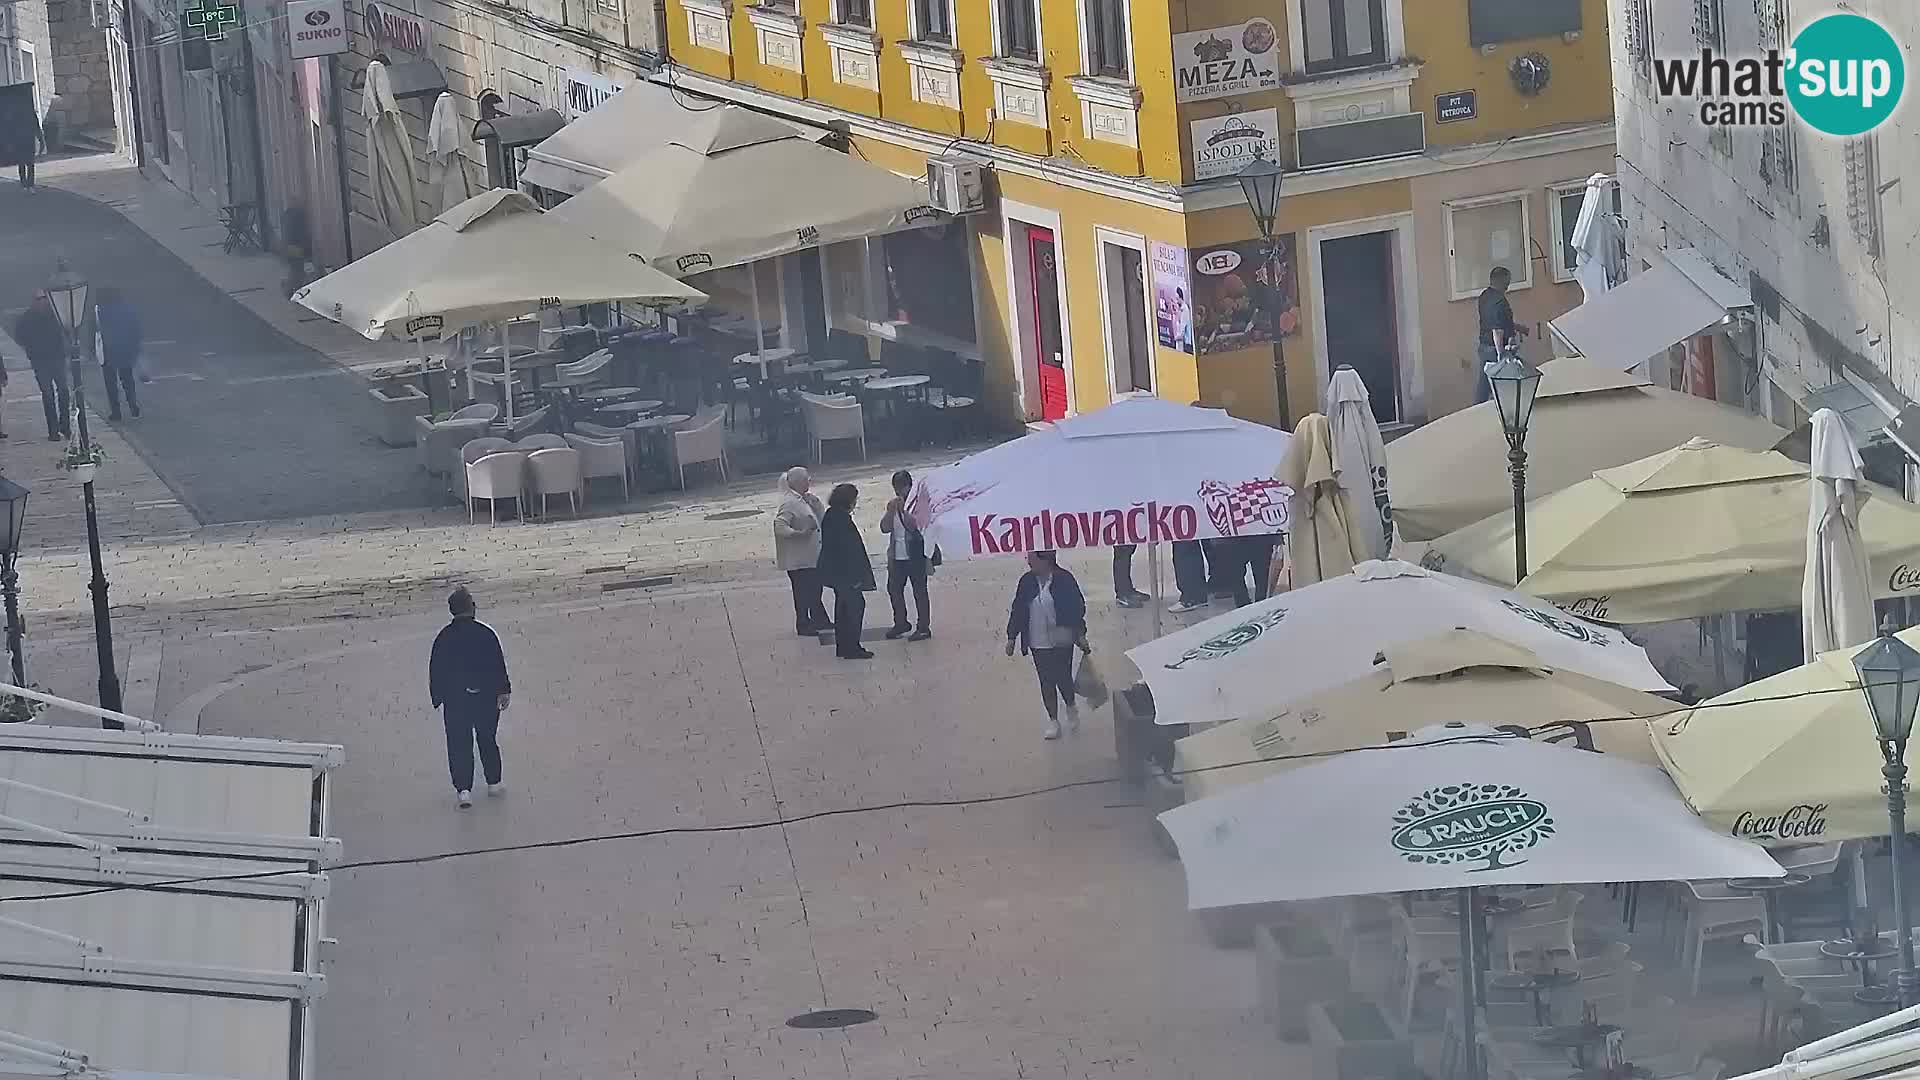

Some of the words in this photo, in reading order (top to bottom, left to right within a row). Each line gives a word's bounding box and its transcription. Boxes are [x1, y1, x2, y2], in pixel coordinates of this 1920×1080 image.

[297, 27, 341, 42] SUKNO
[383, 12, 422, 49] SUKNO
[1179, 58, 1258, 88] MEZA
[1188, 85, 1221, 97] PIZZERIA
[1222, 83, 1228, 92] &
[1229, 80, 1250, 91] GRILL
[1450, 97, 1461, 106] PUT
[1198, 143, 1243, 162] ISPOD
[968, 501, 1198, 555] Karlovačko
[1430, 804, 1530, 842] RAUCH
